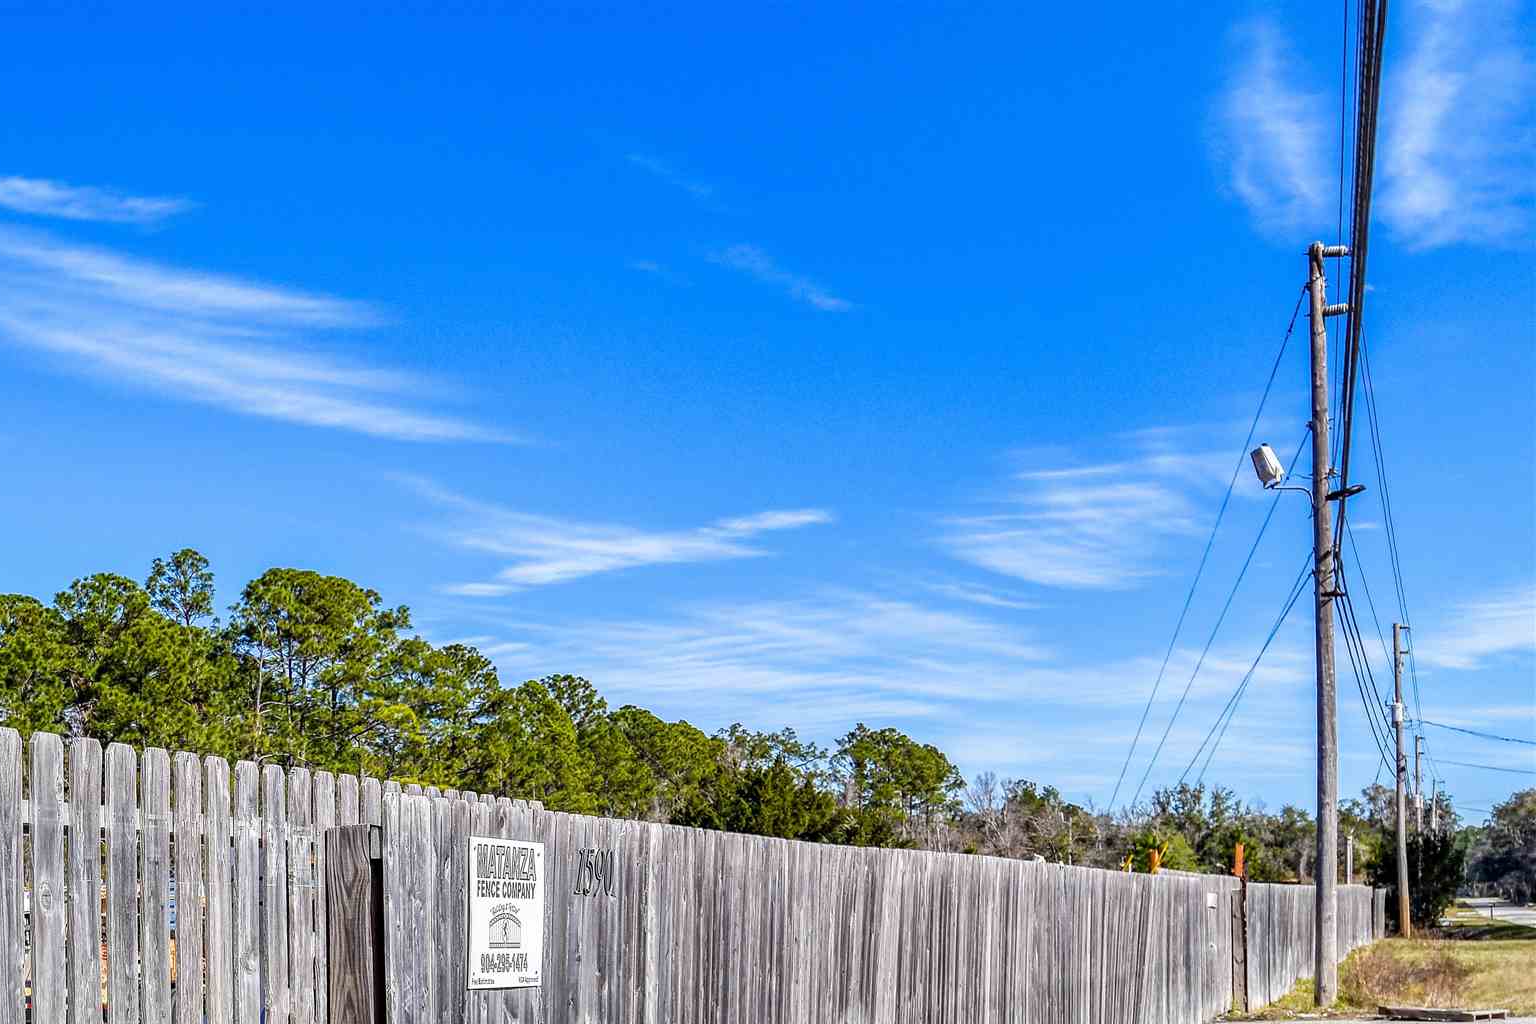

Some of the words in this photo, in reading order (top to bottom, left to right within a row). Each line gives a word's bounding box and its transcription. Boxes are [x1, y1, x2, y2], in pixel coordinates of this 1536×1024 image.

[477, 843, 537, 881] MATANZA
[574, 848, 615, 897] 1590
[477, 880, 500, 898] FENCE
[502, 881, 536, 899] COMPANY
